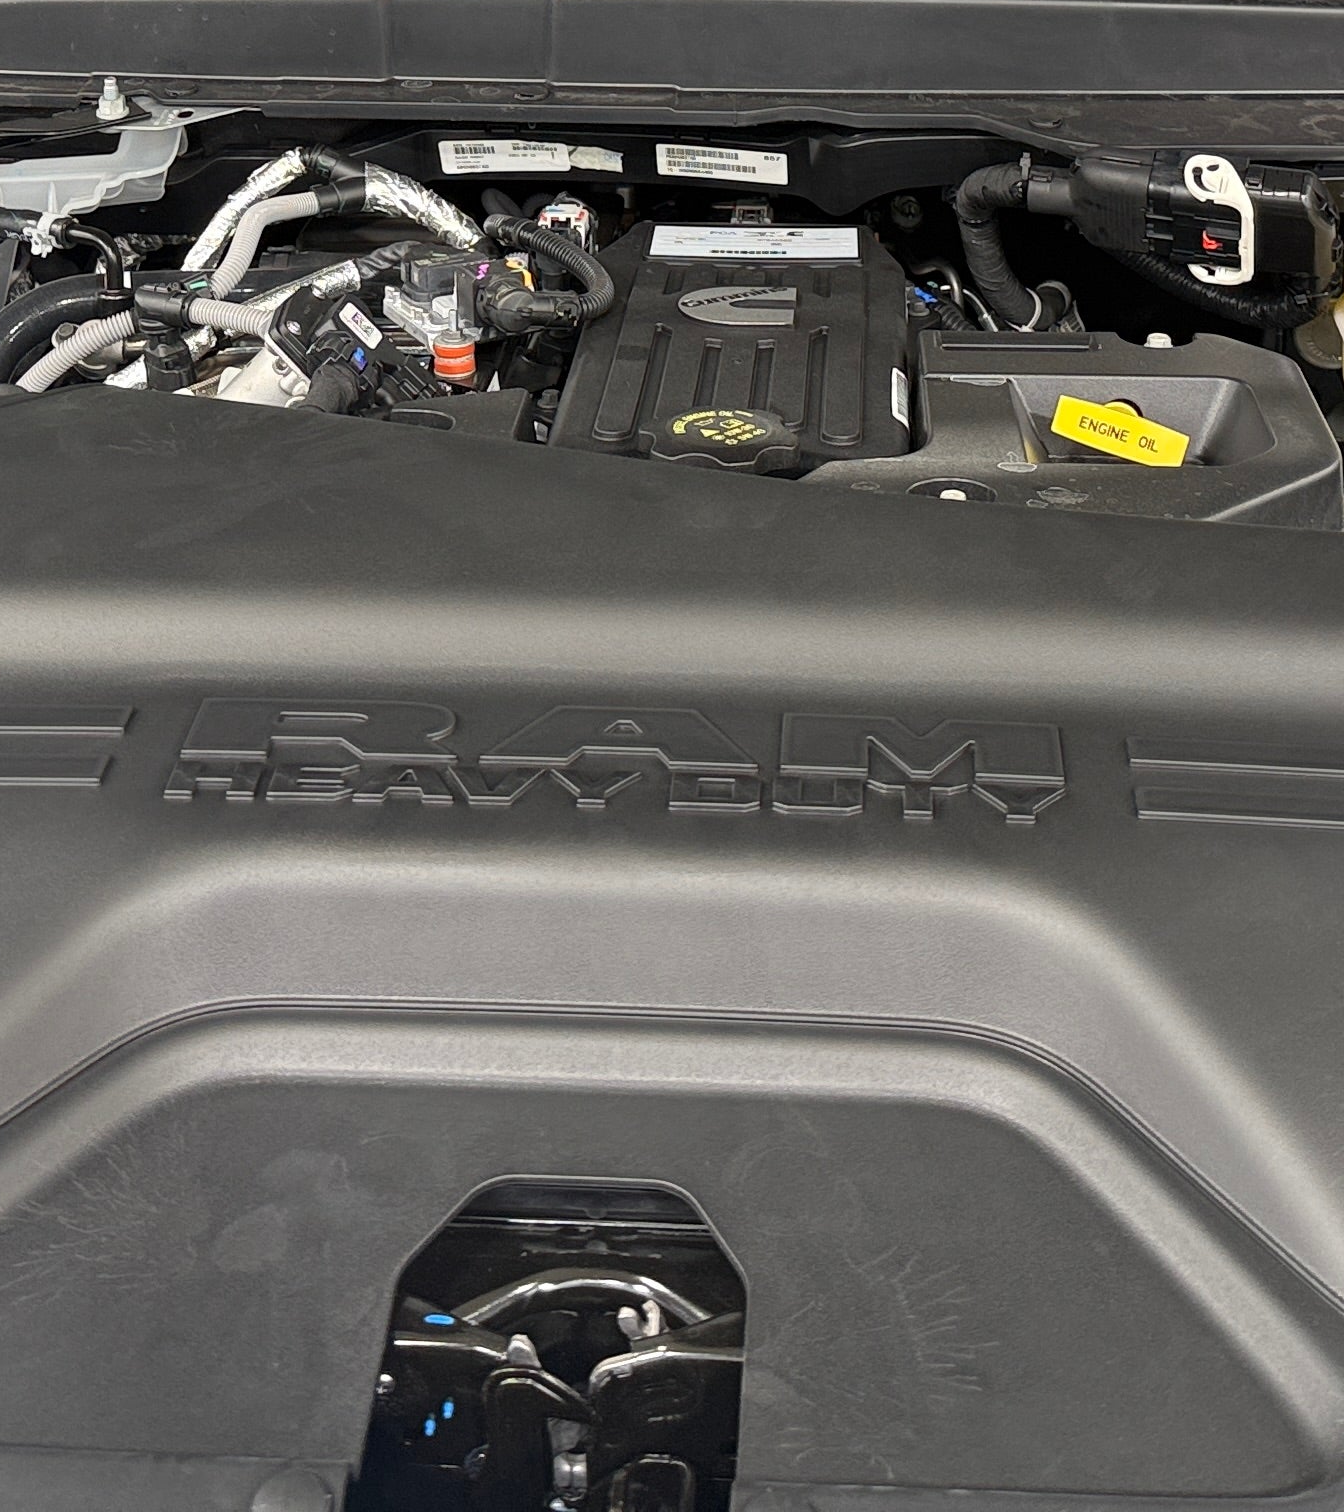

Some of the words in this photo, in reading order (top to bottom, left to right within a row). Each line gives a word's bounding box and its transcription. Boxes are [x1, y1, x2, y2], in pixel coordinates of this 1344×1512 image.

[1078, 415, 1131, 443] ENGINE
[1138, 435, 1159, 454] OIL
[178, 697, 1065, 786] RAM
[162, 760, 644, 809] HEAVY
[667, 770, 1066, 825] DUTY
